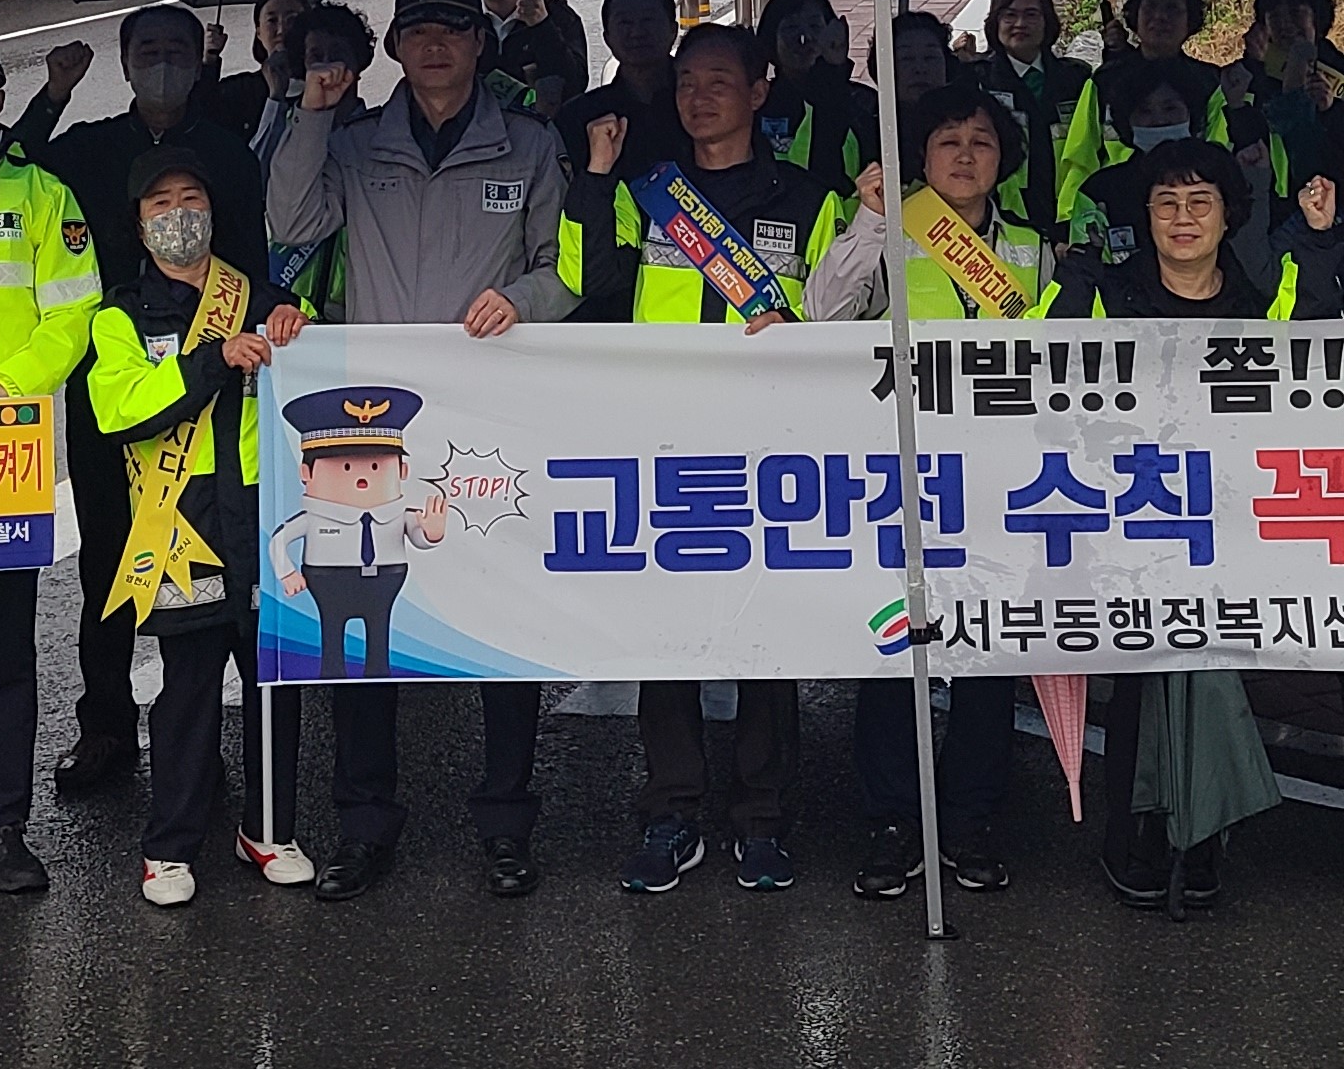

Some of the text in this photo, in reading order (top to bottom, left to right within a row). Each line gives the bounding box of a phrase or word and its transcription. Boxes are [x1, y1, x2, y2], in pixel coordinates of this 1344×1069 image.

[486, 201, 519, 210] POLICE
[667, 177, 725, 242] 방어보행
[673, 217, 706, 258] 서다!
[758, 225, 792, 239] 자율방범
[870, 340, 1137, 414] 제발!!!
[449, 476, 511, 502] STOP!
[544, 454, 967, 572] 교통안전
[1002, 451, 1214, 568] 수칙
